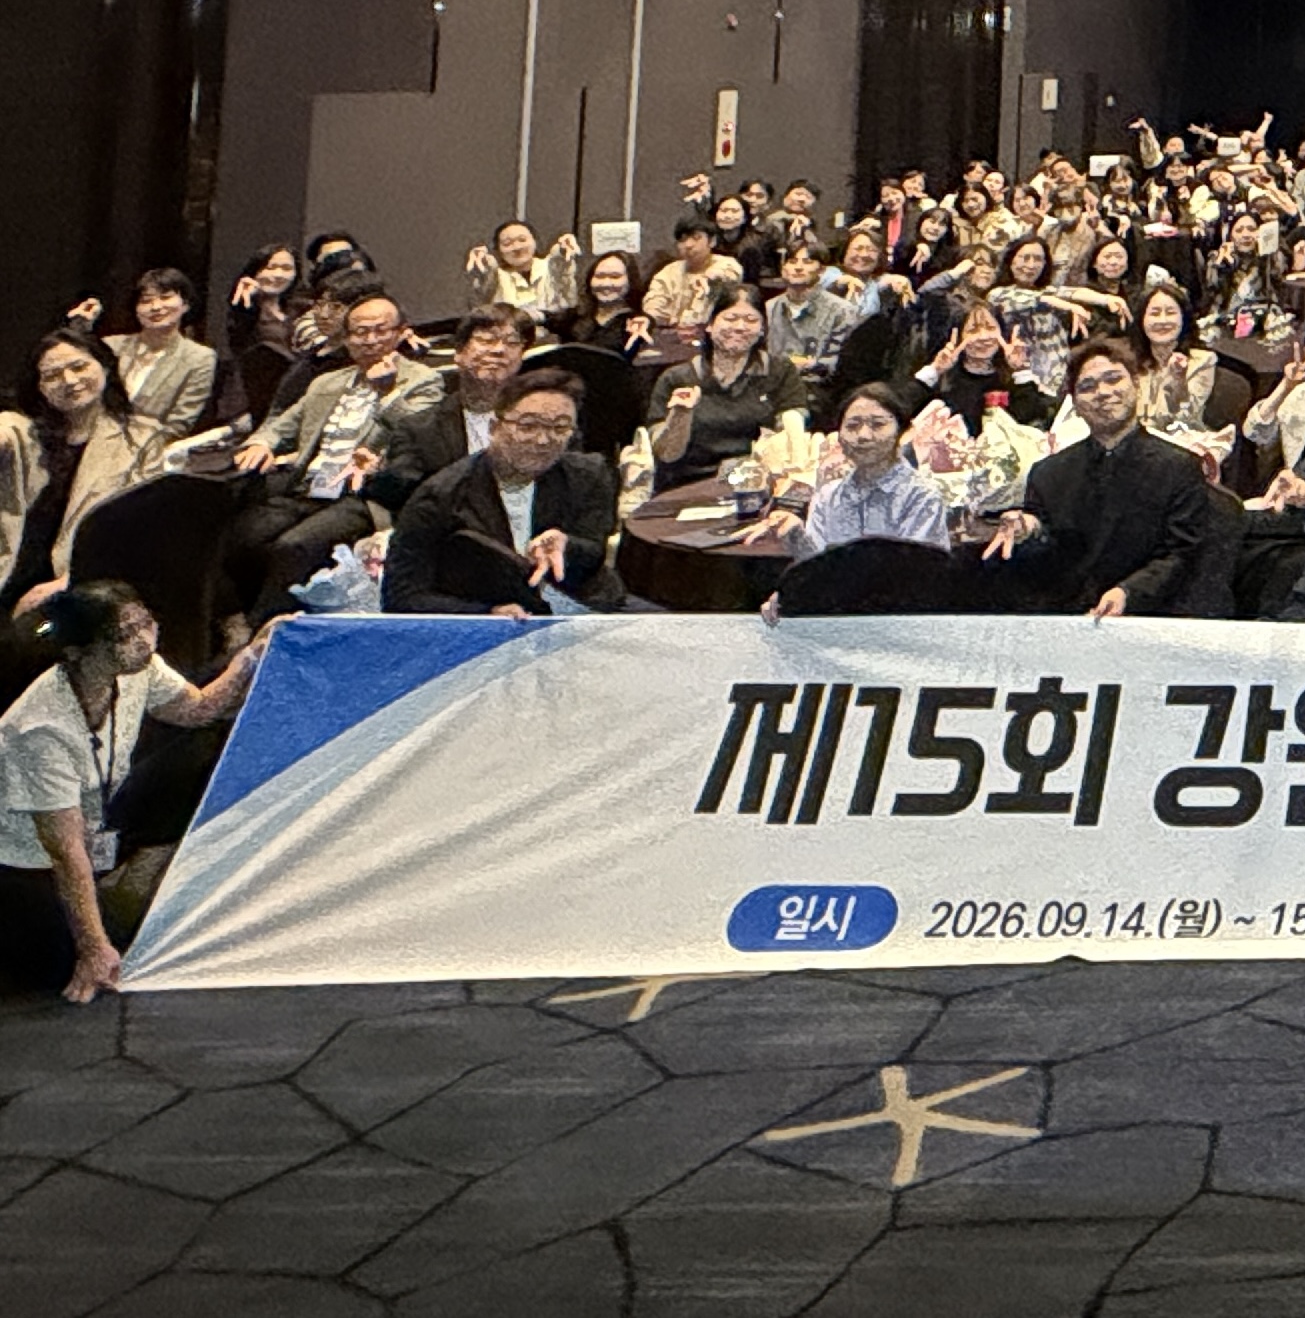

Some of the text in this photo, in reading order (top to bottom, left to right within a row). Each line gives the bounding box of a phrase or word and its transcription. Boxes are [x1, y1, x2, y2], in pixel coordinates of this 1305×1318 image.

[694, 677, 1122, 826] 제15회
[775, 896, 856, 940] 일시
[924, 898, 1222, 938] 2026.09.14.(월)
